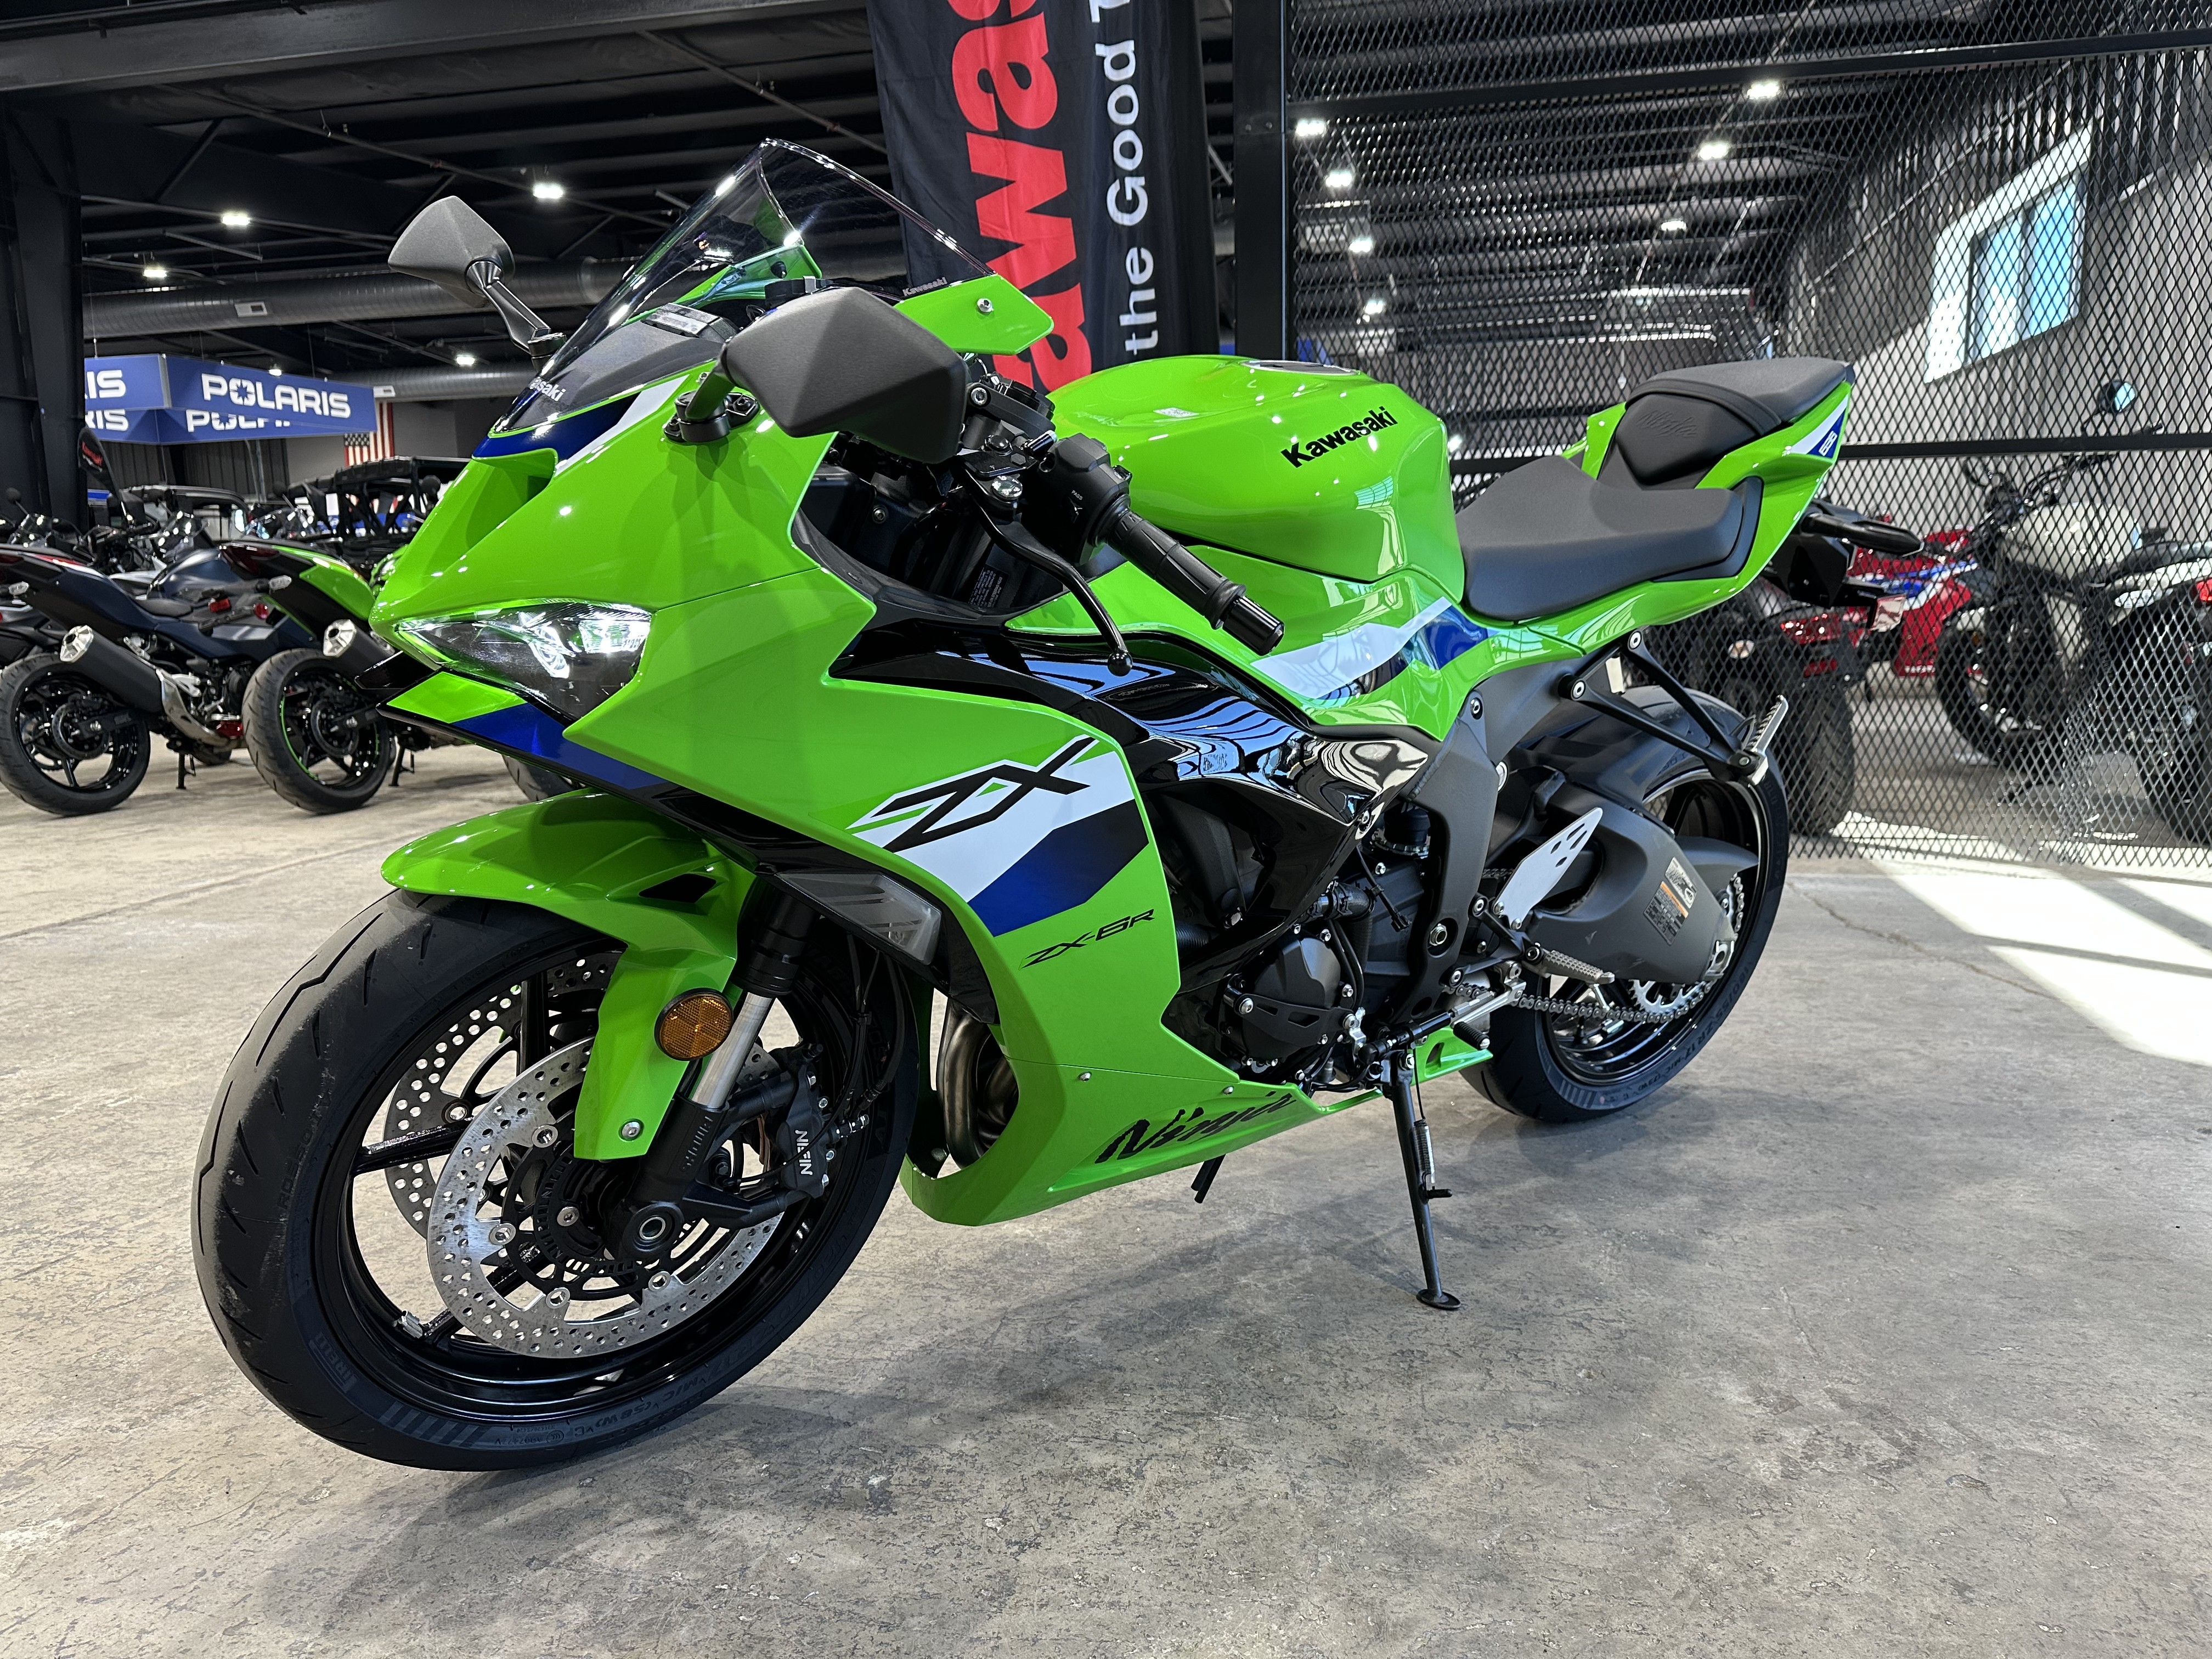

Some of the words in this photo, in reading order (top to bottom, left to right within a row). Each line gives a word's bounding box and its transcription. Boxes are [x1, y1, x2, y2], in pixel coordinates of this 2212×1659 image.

[1096, 40, 1148, 227] Good
[902, 276, 948, 296] Kawasaki
[1119, 246, 1159, 355] the
[84, 369, 126, 399] IS
[201, 373, 352, 419] POLARIS
[1280, 407, 1398, 468] Kawasaki
[1071, 489, 1083, 500] PASS
[870, 737, 1096, 853] ZX
[1021, 909, 1155, 969] ZX-6R
[1094, 1091, 1297, 1164] Ninja
